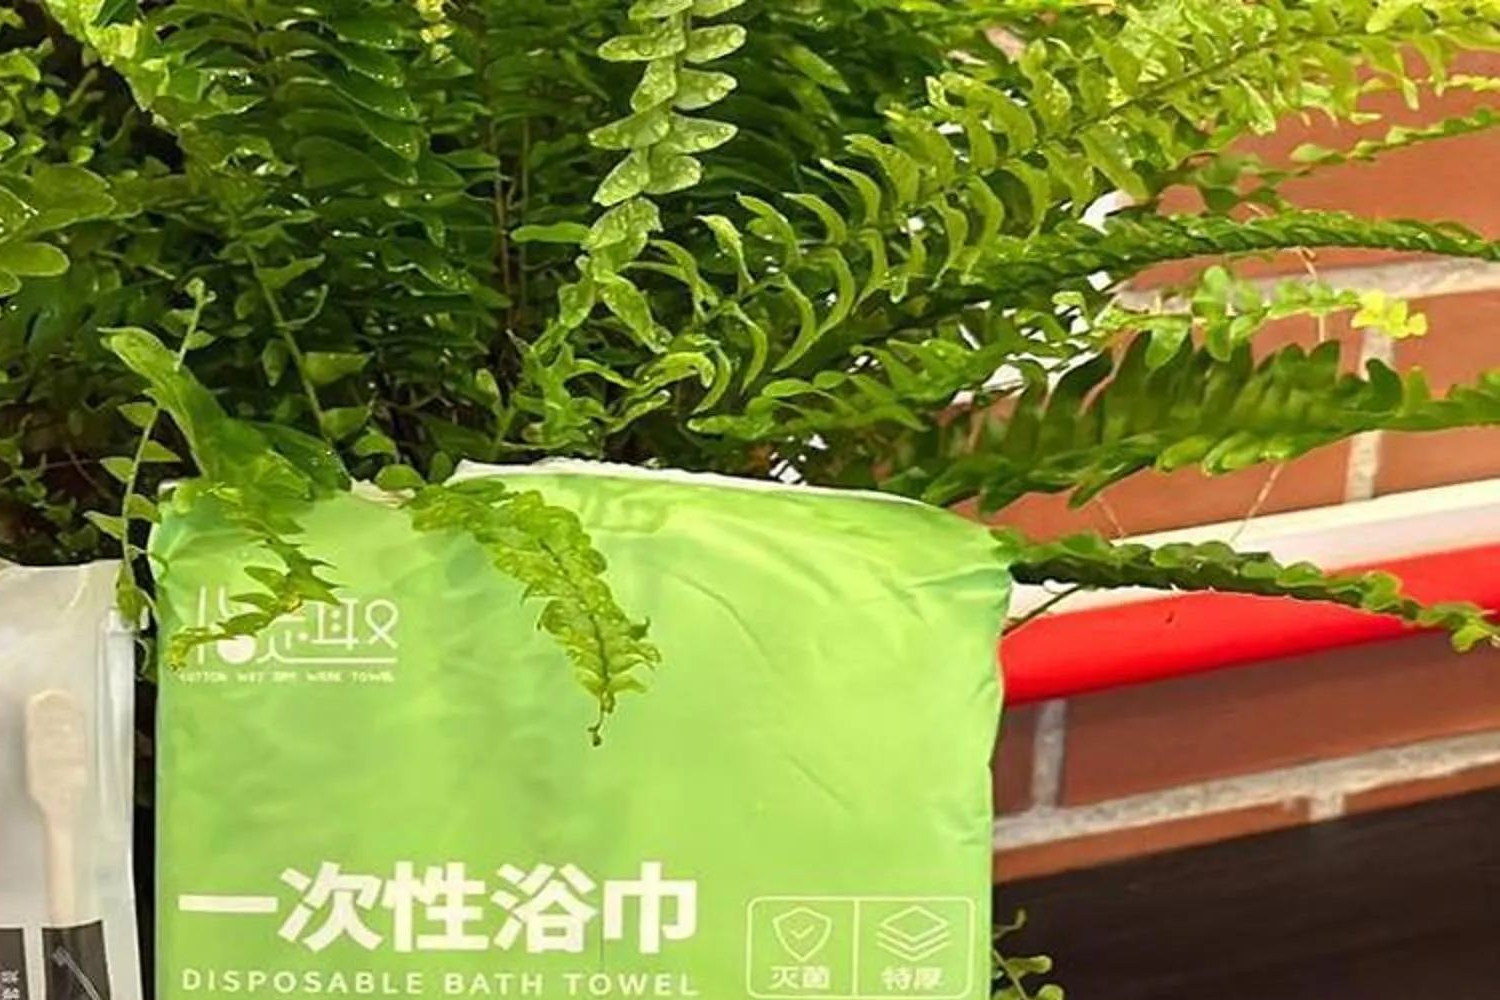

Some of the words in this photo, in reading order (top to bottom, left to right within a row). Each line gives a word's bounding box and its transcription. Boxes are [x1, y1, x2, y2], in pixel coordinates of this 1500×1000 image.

[178, 861, 698, 954] 一次性浴巾
[181, 968, 424, 995] DISPOSABLE
[445, 972, 543, 996] BATH
[566, 974, 699, 996] TOWEL
[770, 966, 830, 990] 灭菌
[881, 966, 944, 990] 特厚
